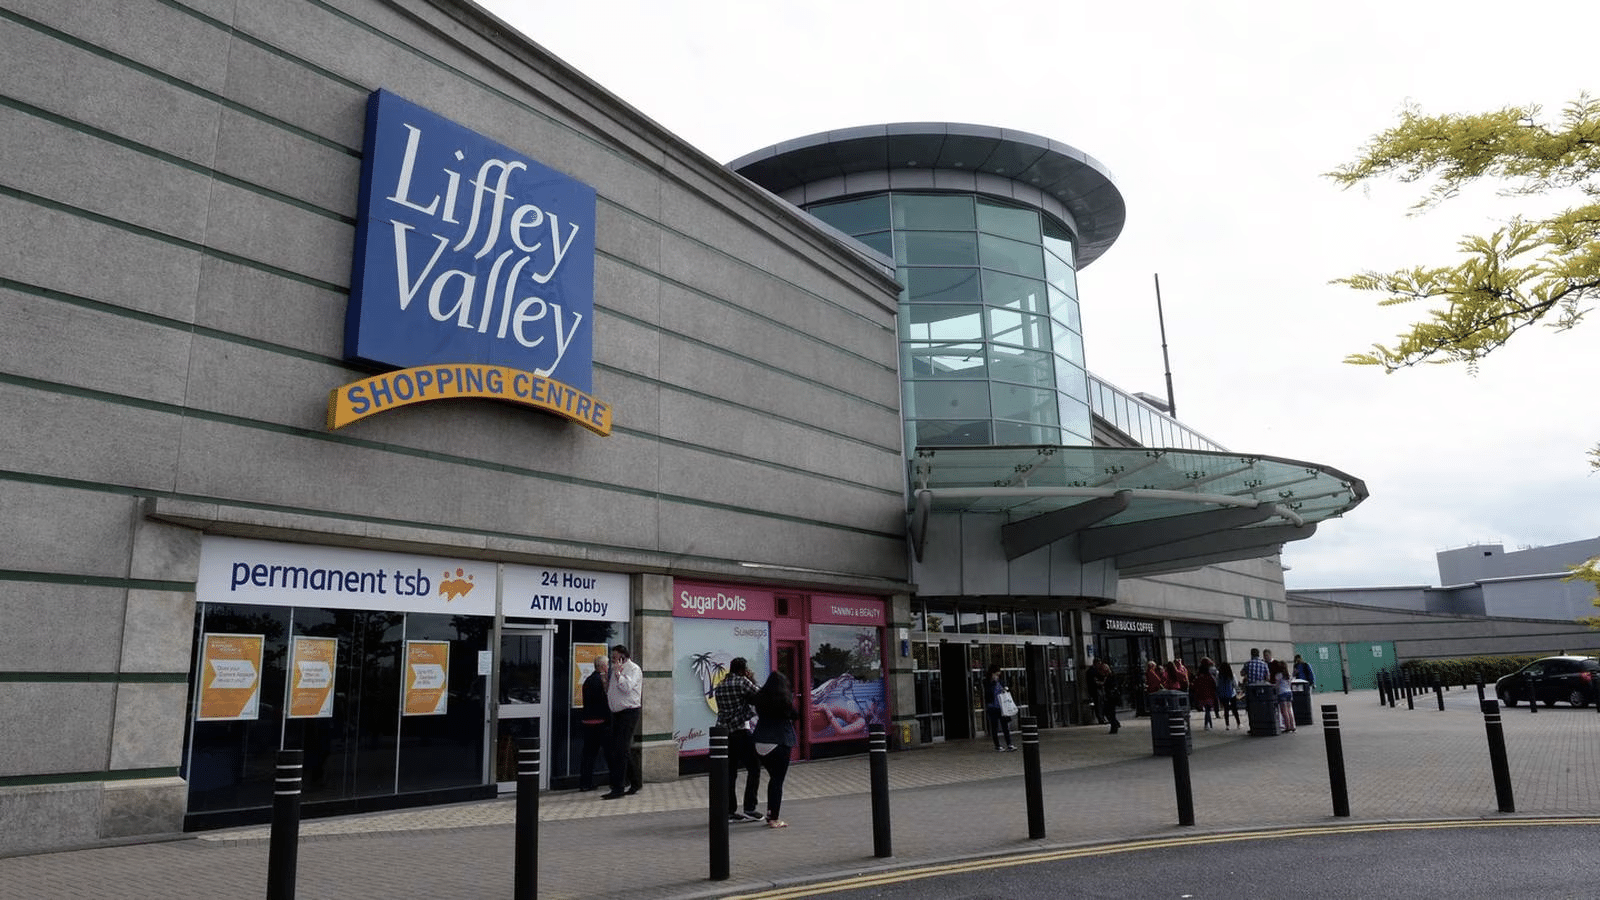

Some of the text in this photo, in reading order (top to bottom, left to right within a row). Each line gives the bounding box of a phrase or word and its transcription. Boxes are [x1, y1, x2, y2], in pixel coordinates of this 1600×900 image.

[386, 123, 580, 284] Liffey
[389, 219, 583, 377] Valley
[347, 367, 607, 427] SHOPPING CENTRE
[231, 561, 431, 597] permanent tsb
[541, 571, 597, 590] 24 Hour
[530, 594, 608, 617] ATM Lobby
[1106, 619, 1154, 632] STARBUCKS COFFEE
